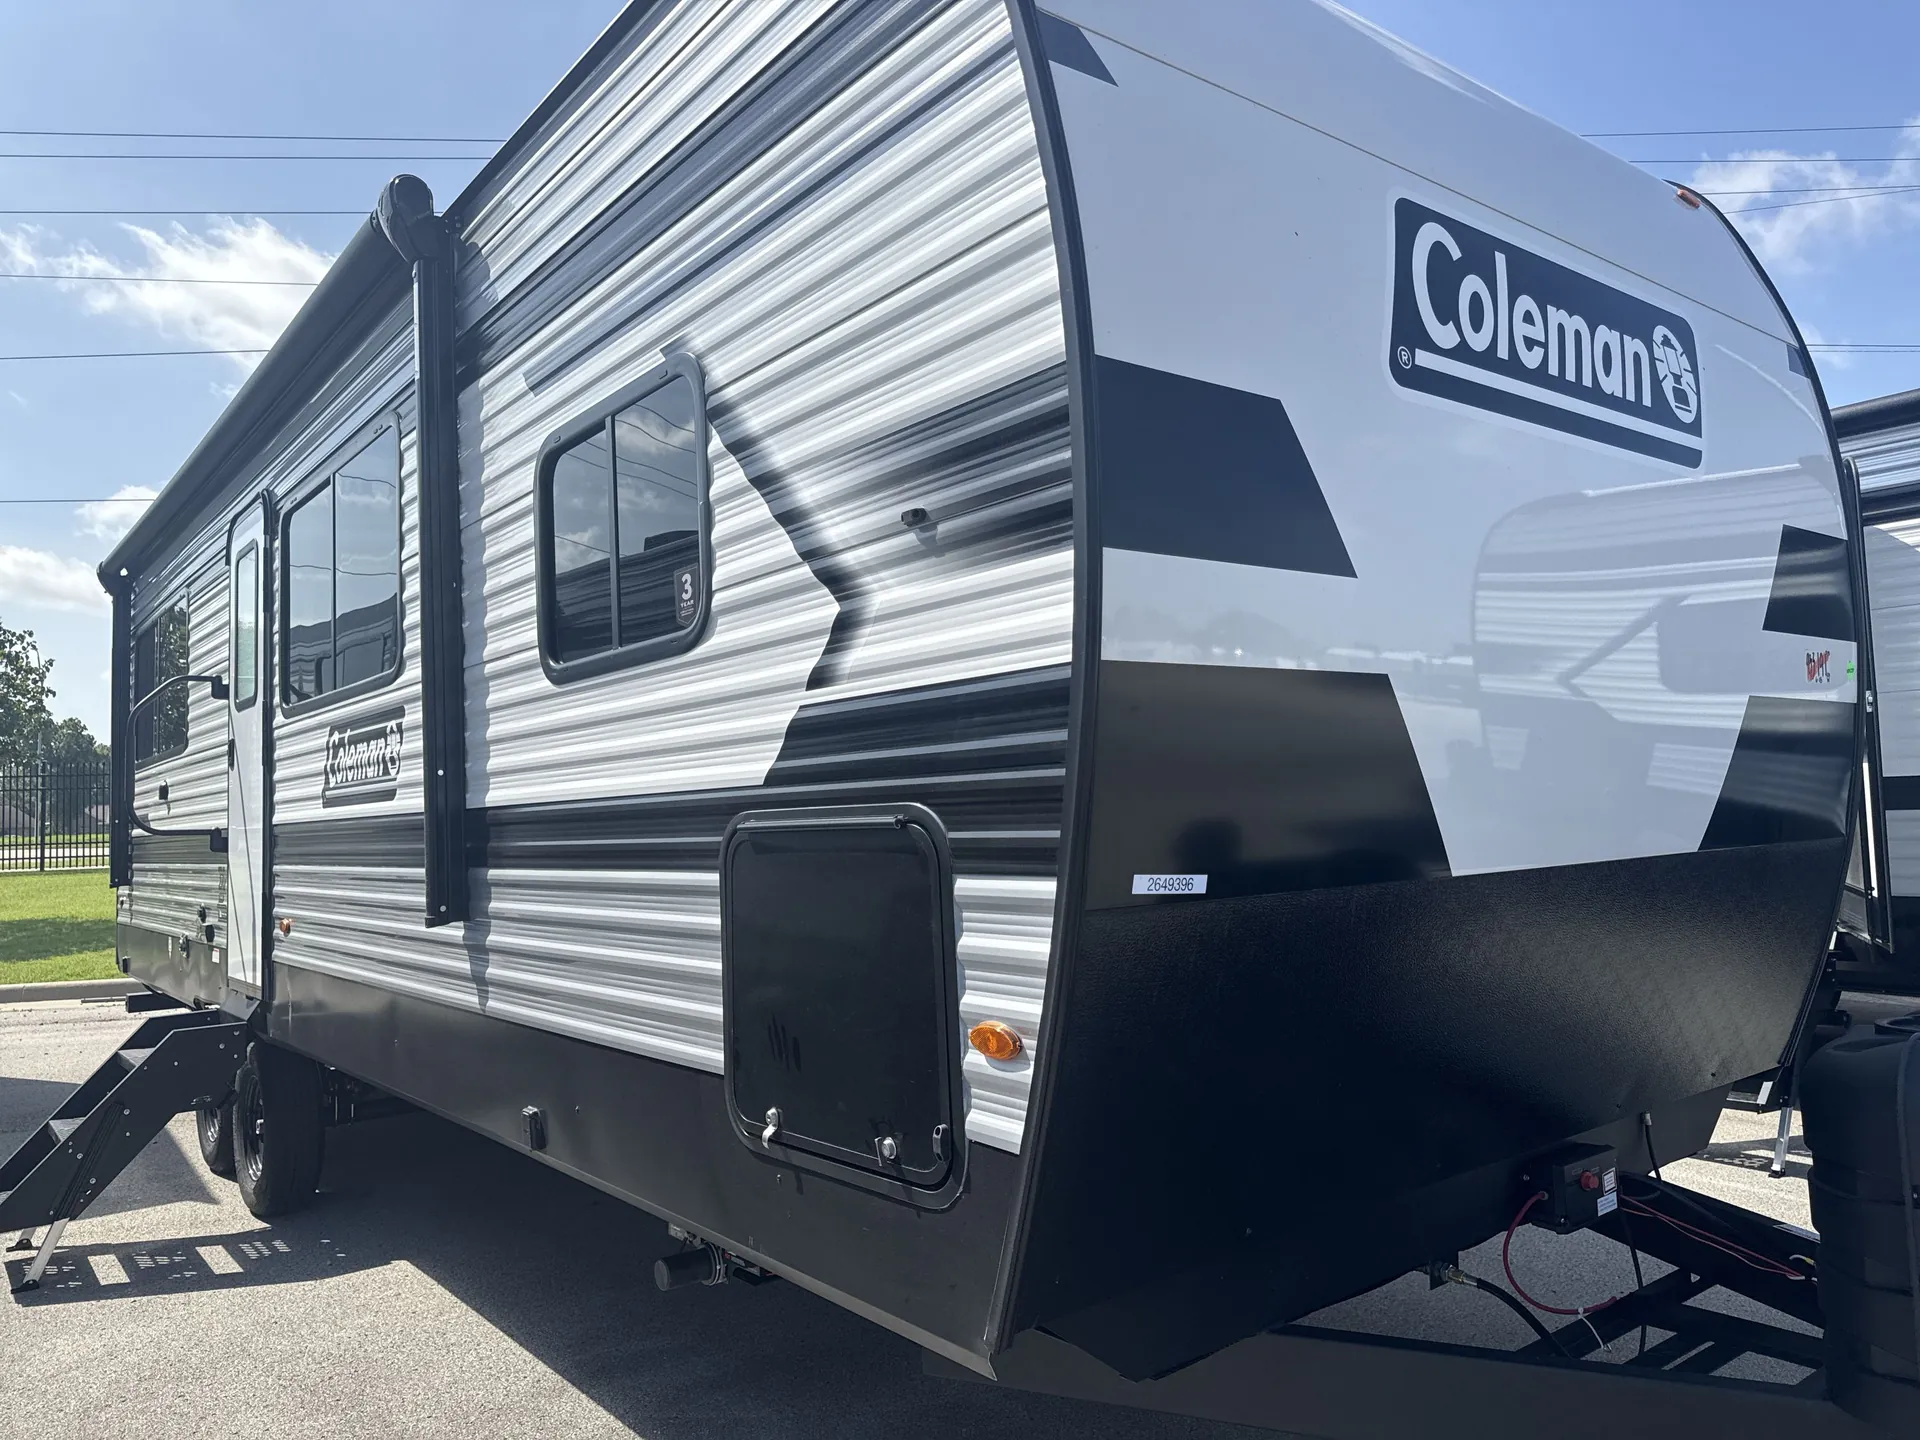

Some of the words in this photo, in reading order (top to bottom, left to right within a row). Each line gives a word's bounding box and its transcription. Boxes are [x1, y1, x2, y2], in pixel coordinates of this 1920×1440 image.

[1412, 221, 1652, 408] Coleman
[681, 573, 692, 600] 3
[680, 599, 695, 608] YEAR
[327, 728, 386, 788] Coleman
[1147, 877, 1194, 892] 2649396
